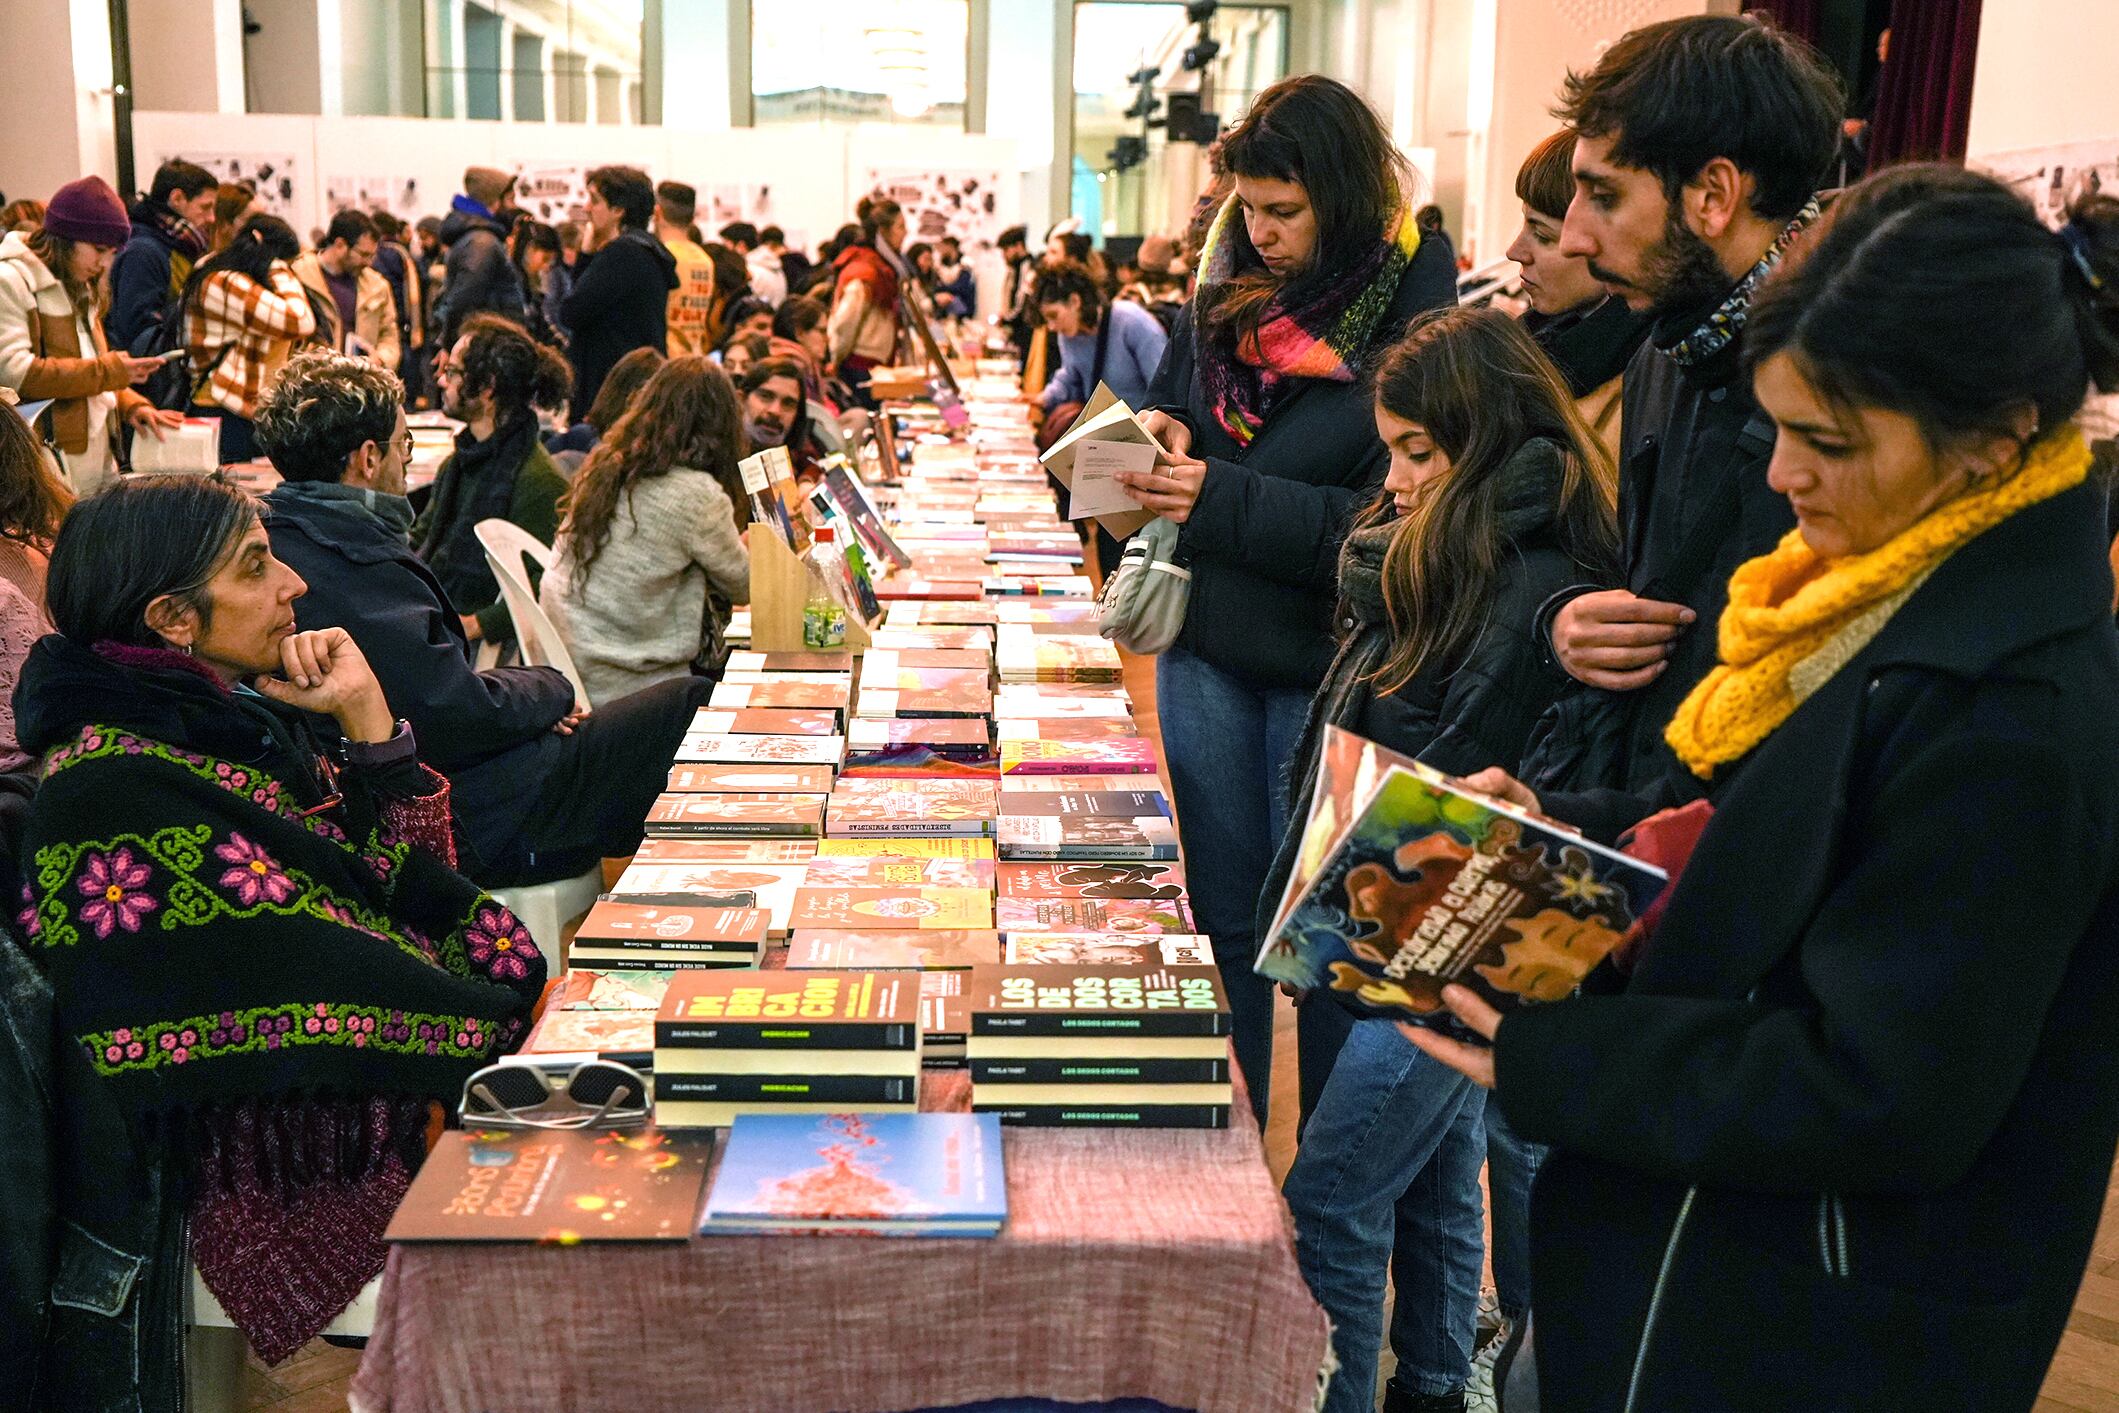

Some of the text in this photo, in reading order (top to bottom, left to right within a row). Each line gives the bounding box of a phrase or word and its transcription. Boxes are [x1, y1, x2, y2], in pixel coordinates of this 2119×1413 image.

[688, 996, 726, 1016] IM
[726, 988, 766, 1016] BRI
[764, 992, 799, 1016] CA
[800, 978, 840, 1016] CION
[1001, 977, 1035, 1009] LOS
[1038, 987, 1072, 1009] DE
[1074, 976, 1108, 1009] DOS
[1109, 977, 1144, 1009] COR
[1146, 988, 1180, 1010] TA
[1179, 978, 1218, 1010] DOS
